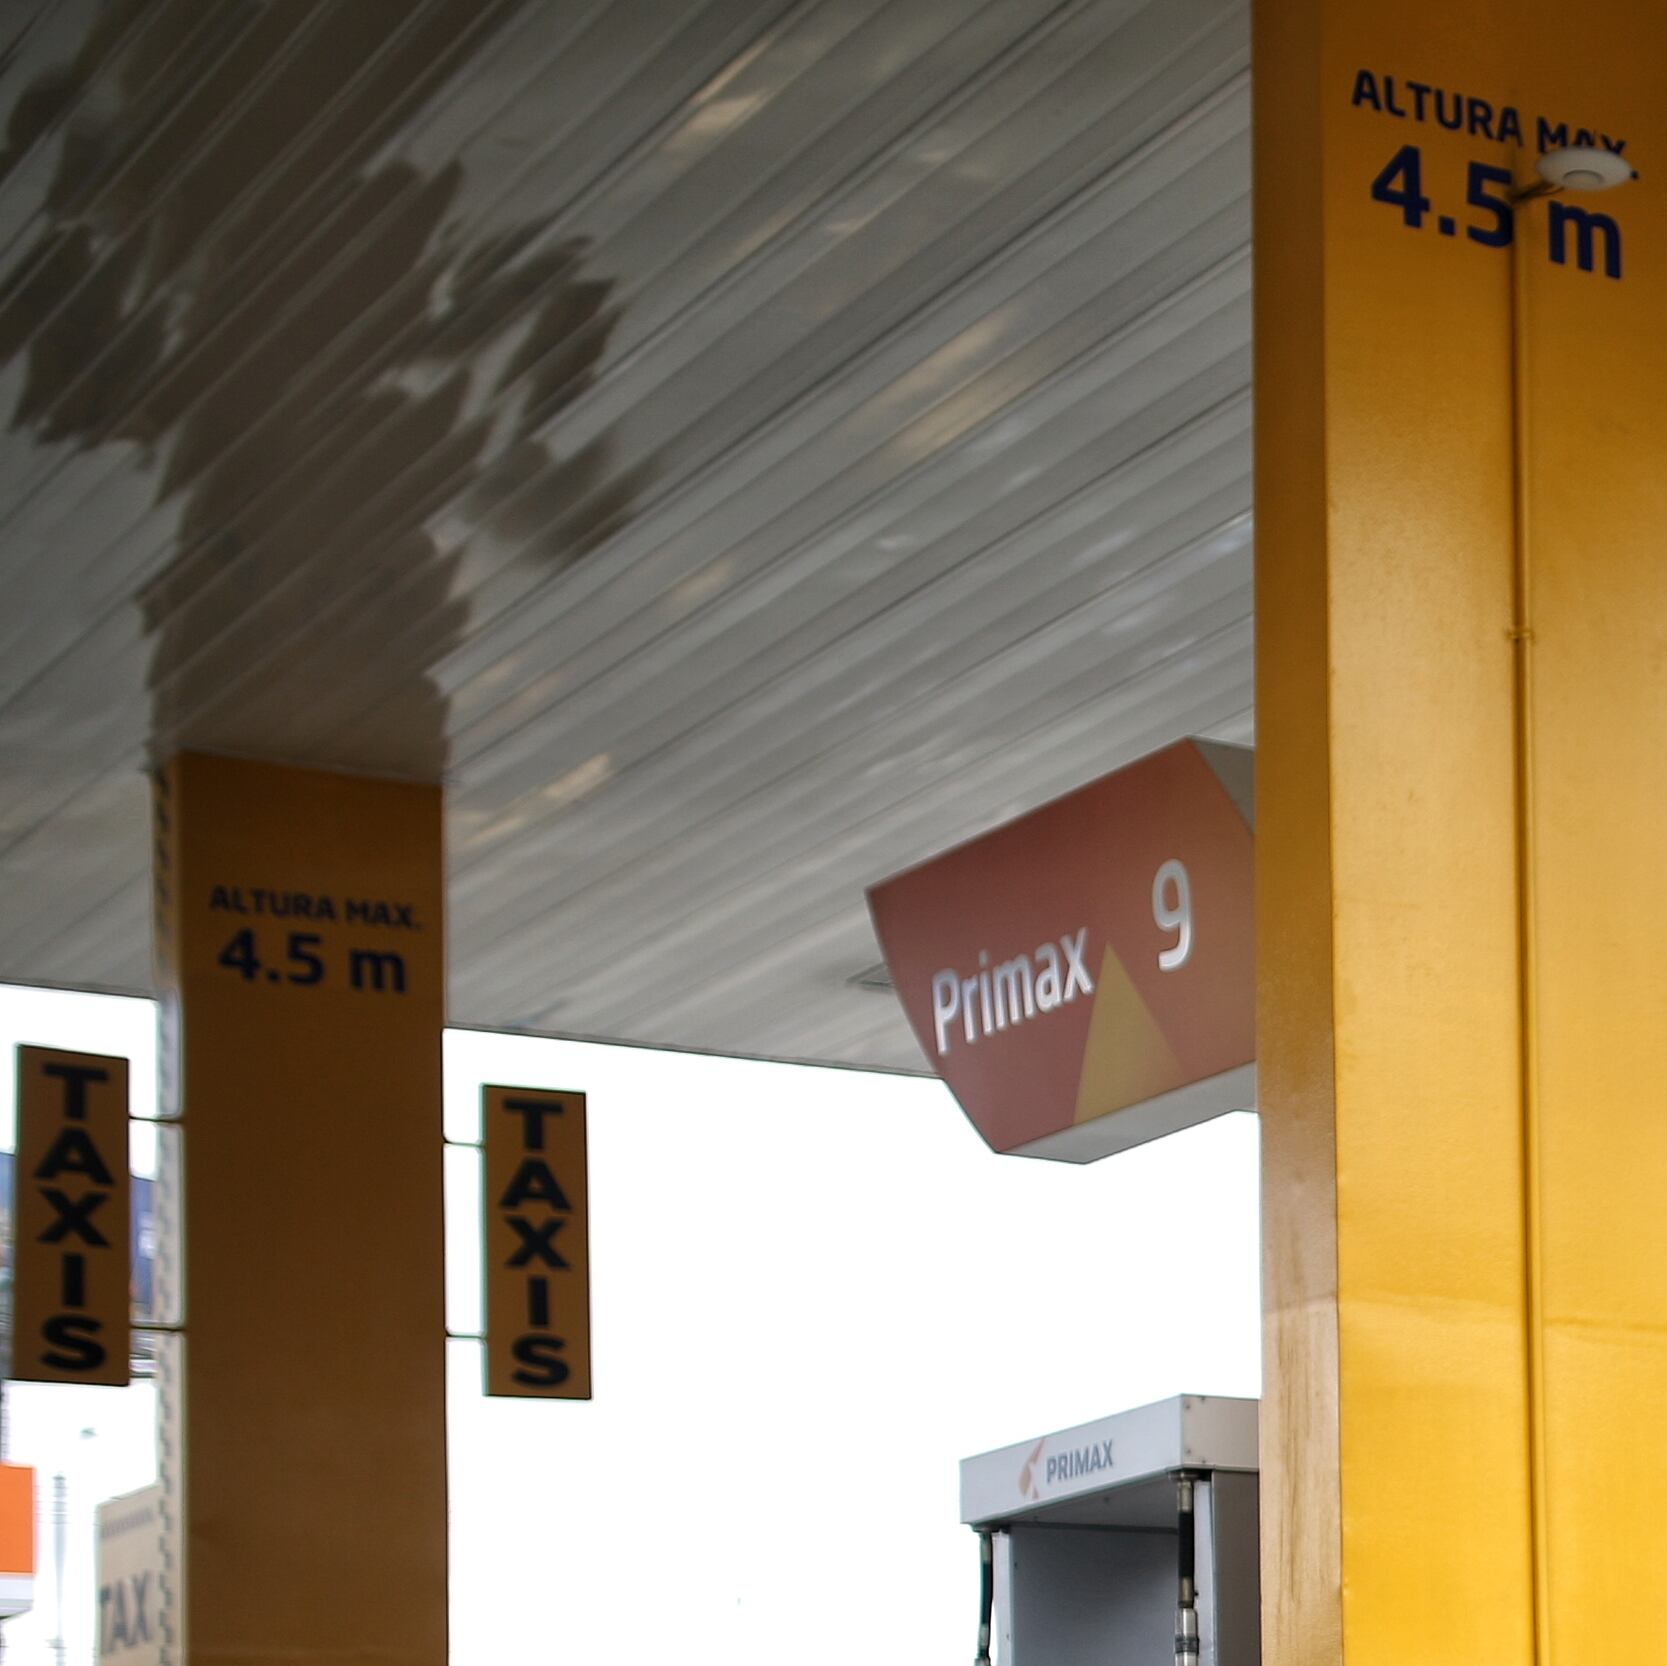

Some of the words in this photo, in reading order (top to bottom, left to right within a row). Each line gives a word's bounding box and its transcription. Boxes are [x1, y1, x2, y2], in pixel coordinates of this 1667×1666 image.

[1352, 68, 1524, 149] ALTURA
[1371, 144, 1514, 250] 4.5
[1548, 199, 1621, 281] m
[209, 885, 337, 921] ALTURA
[1152, 858, 1193, 972] 9
[218, 929, 324, 987] 4.5
[349, 948, 406, 993] m
[932, 926, 1095, 1057] Primax
[33, 1062, 116, 1373] TAXIS
[499, 1095, 573, 1389] TAXIS
[1046, 1438, 1113, 1485] PRIMAX
